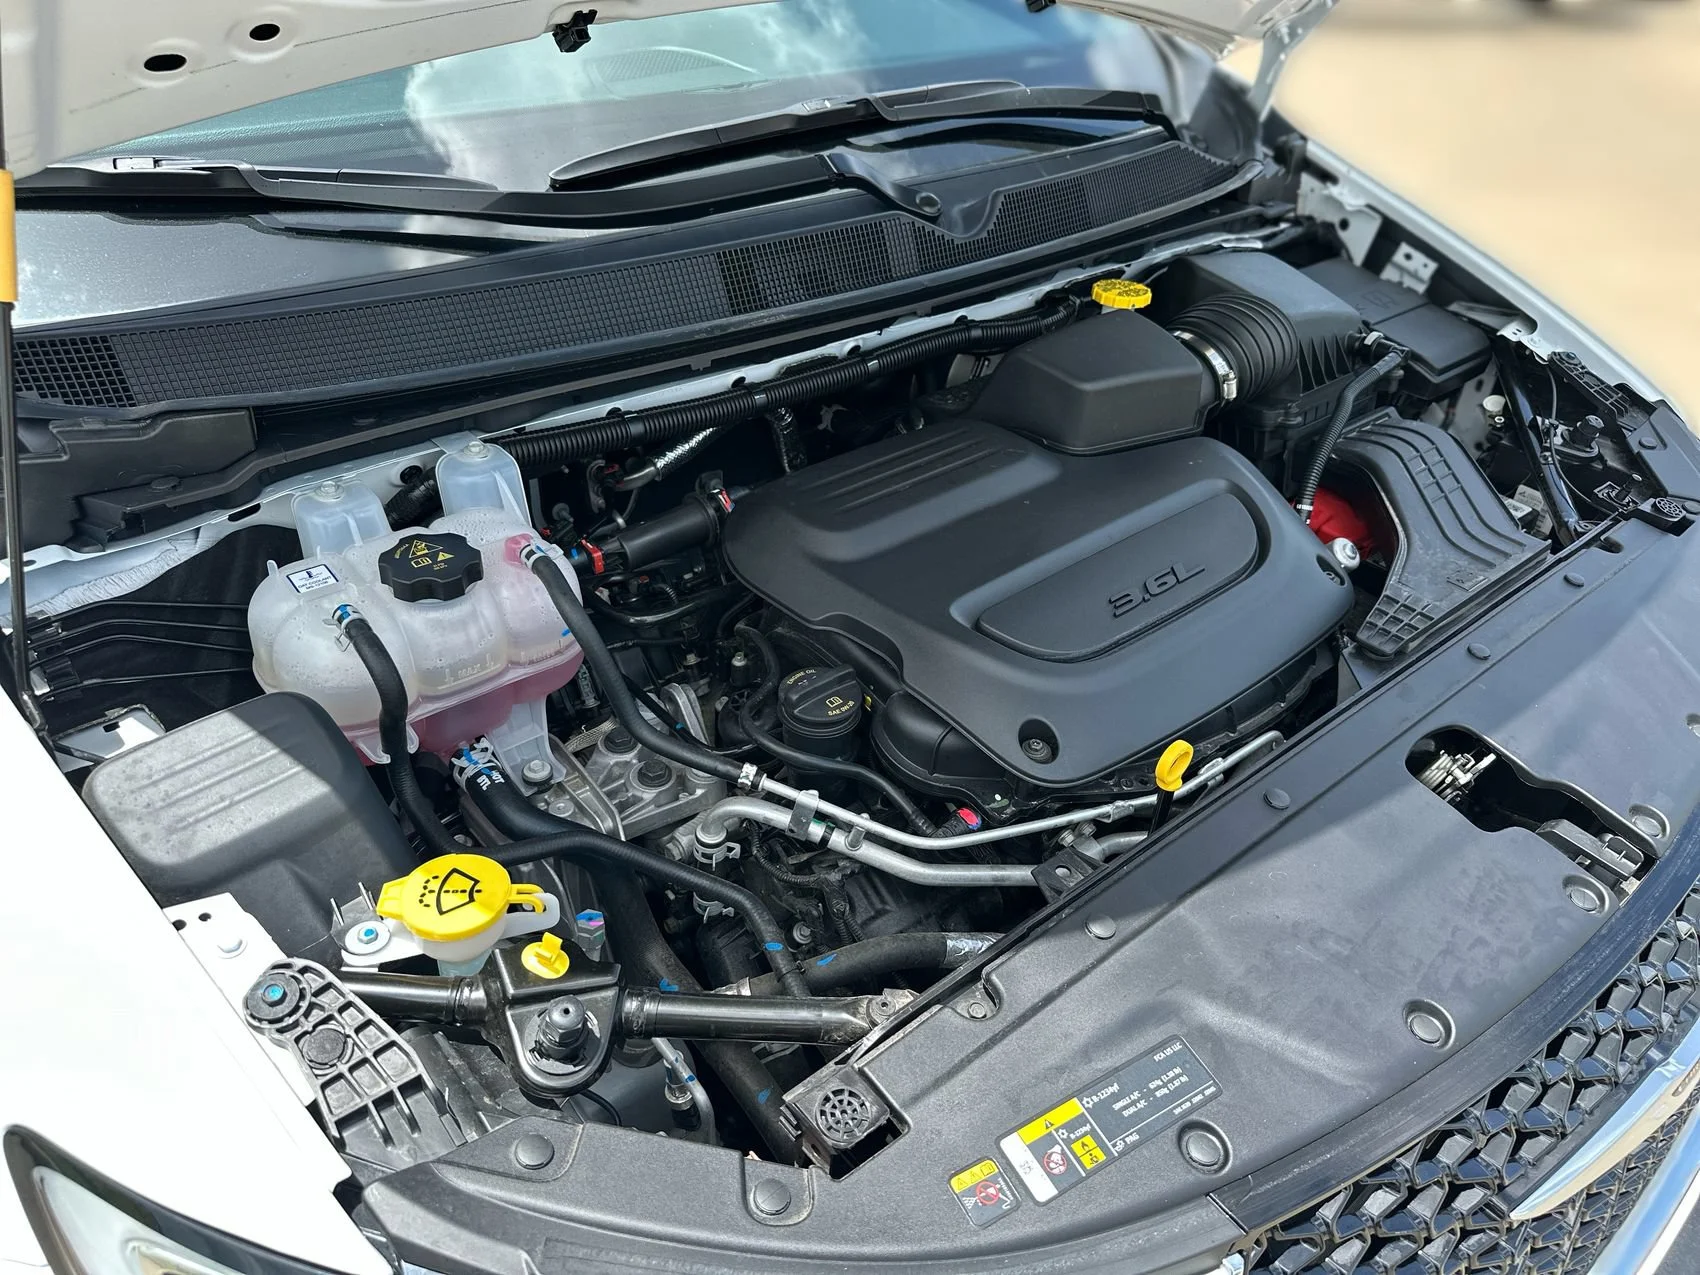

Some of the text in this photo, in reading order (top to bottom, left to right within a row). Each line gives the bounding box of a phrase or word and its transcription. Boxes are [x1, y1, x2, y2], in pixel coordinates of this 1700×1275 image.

[1108, 562, 1206, 618] 3.6L
[786, 671, 806, 685] ENGINE
[827, 708, 841, 716] SAE
[1153, 1052, 1166, 1062] FCA
[1172, 1041, 1182, 1051] LLC
[1112, 1096, 1131, 1111] SINGLE
[1121, 1103, 1136, 1118] DUAL
[1124, 1133, 1140, 1145] PAG
